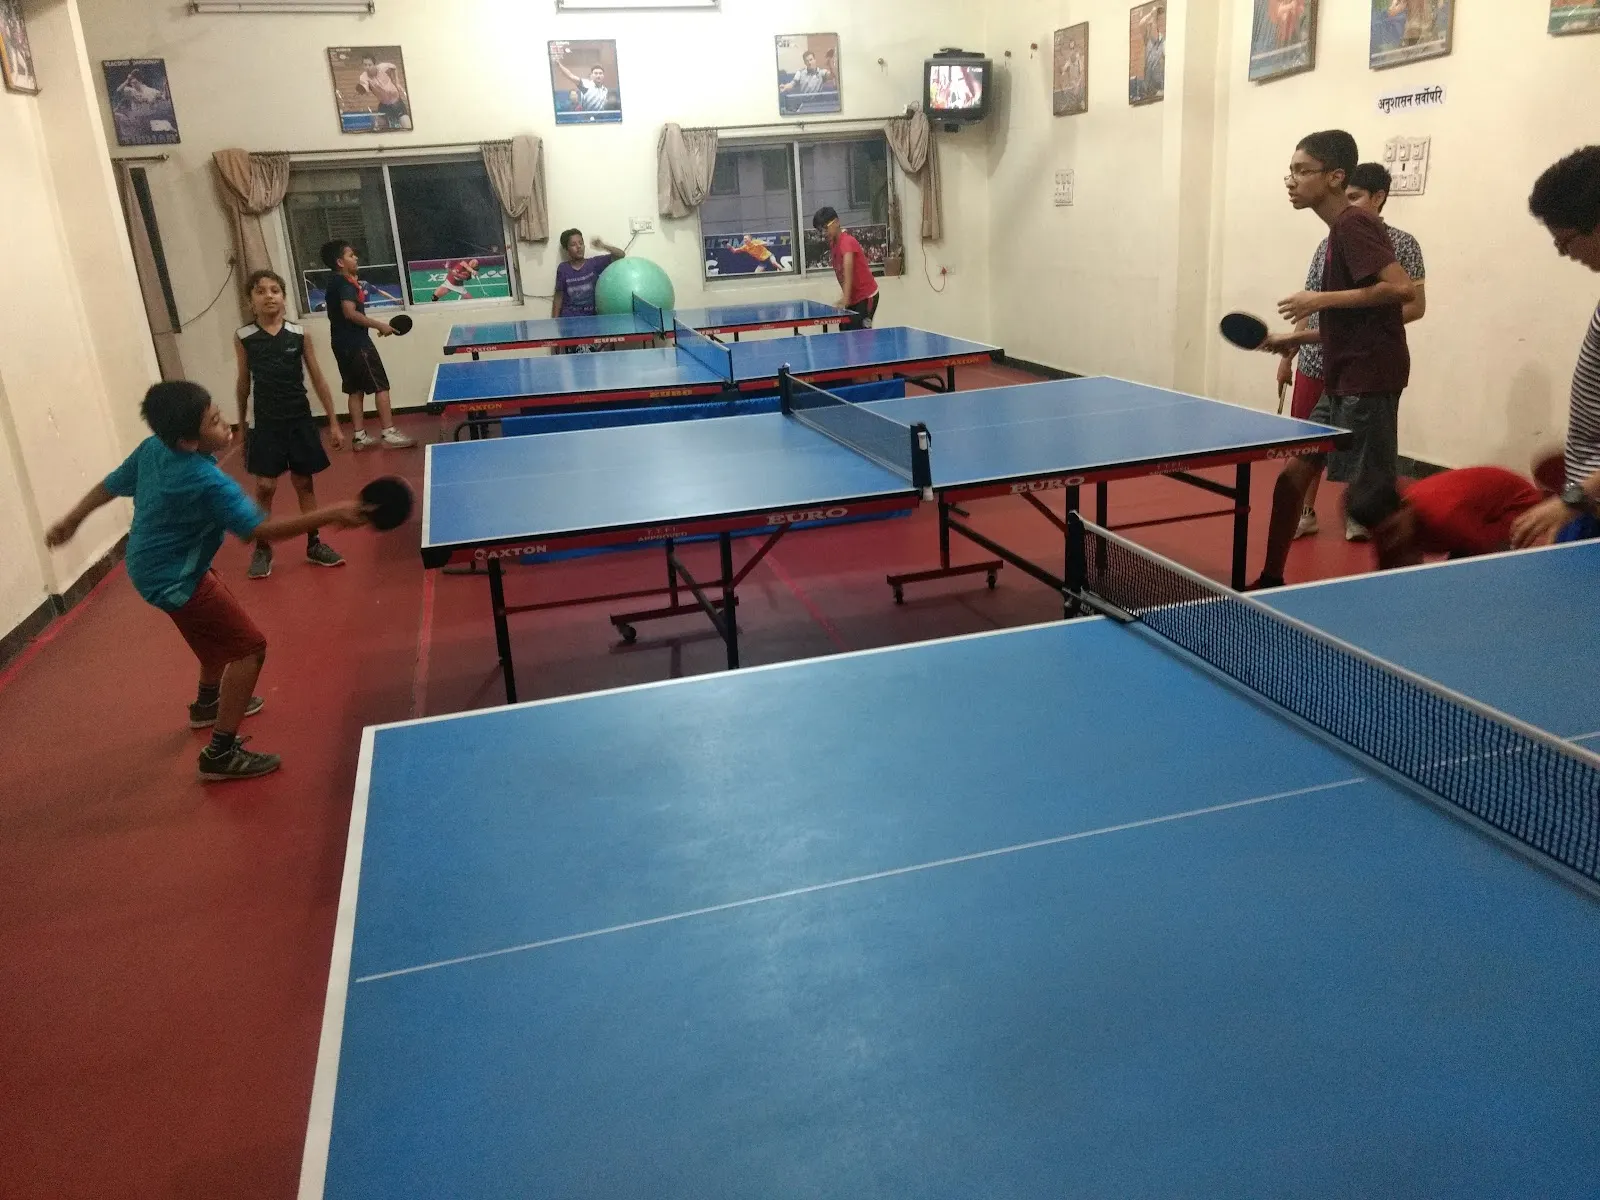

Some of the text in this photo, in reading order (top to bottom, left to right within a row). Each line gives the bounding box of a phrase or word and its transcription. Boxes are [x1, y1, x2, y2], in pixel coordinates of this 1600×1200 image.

[1378, 85, 1443, 114] अनुशासन सर्वोपरि
[1010, 476, 1085, 494] EURO
[766, 507, 848, 525] EURO
